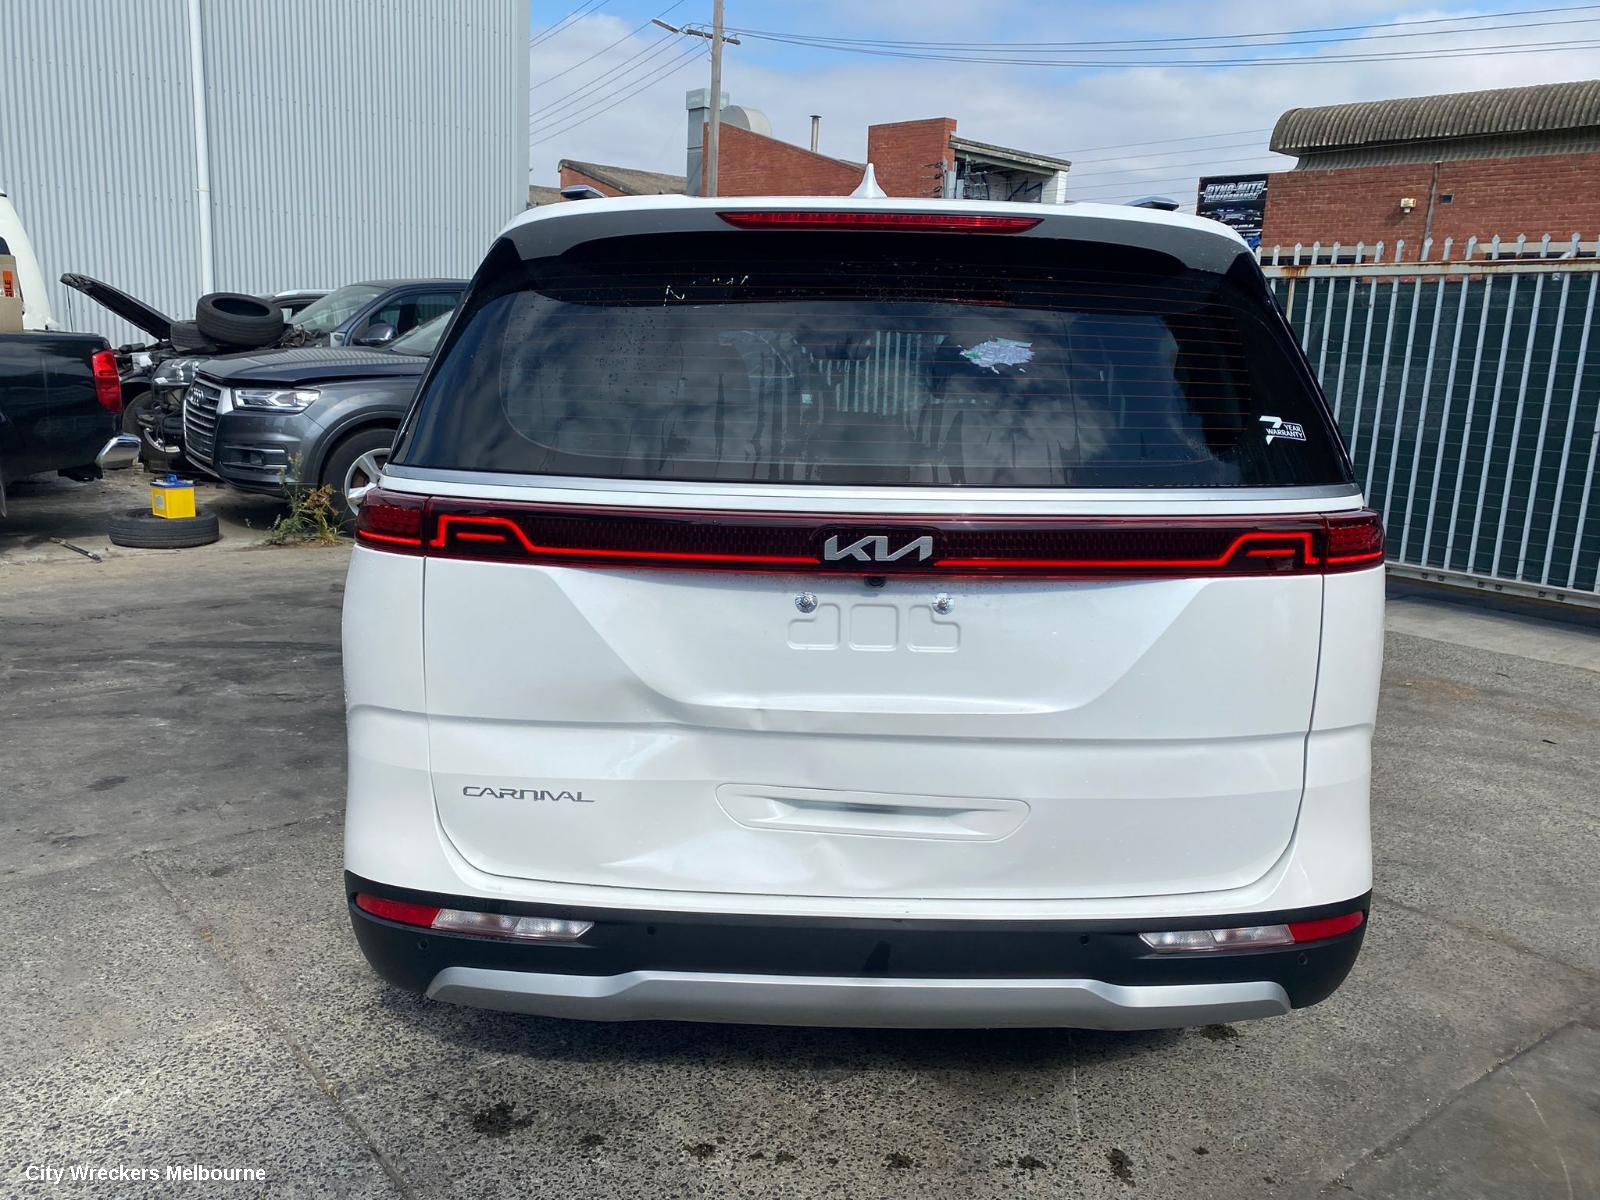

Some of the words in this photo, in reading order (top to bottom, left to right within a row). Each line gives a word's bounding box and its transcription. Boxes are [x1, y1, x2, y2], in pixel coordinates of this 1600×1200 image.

[1206, 183, 1264, 194] DYNO-MITE
[1266, 428, 1303, 438] WARRANTY
[1283, 424, 1302, 432] YEAR
[824, 535, 933, 561] KIA
[463, 786, 595, 802] CARNIVAL
